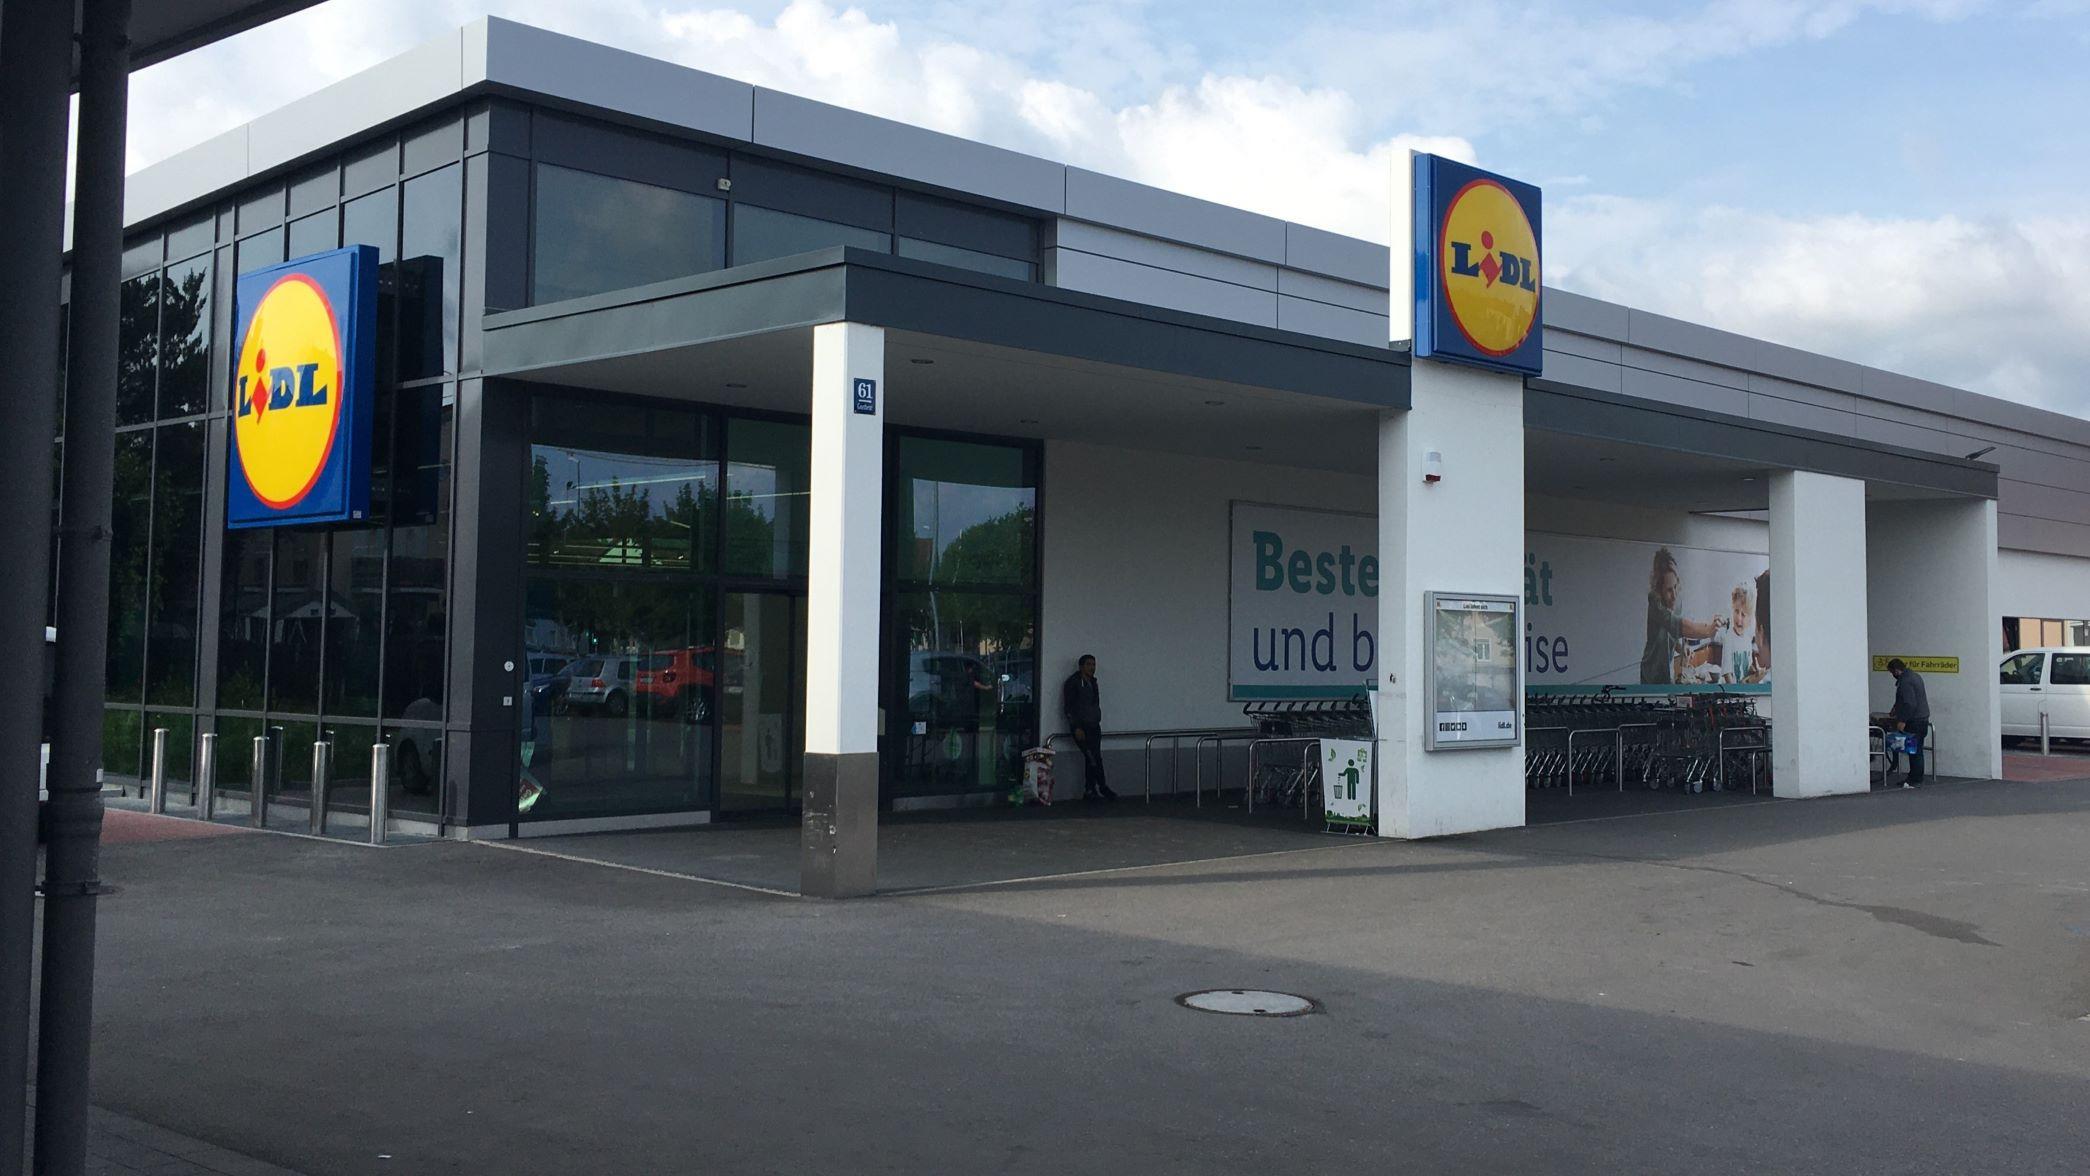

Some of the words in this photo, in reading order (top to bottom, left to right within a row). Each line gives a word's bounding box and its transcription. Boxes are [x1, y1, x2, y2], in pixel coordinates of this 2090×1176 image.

[858, 382, 873, 399] 61
[1253, 530, 1379, 597] Beste
[1253, 611, 1337, 672] und
[1921, 661, 1957, 669] Fahrräder
